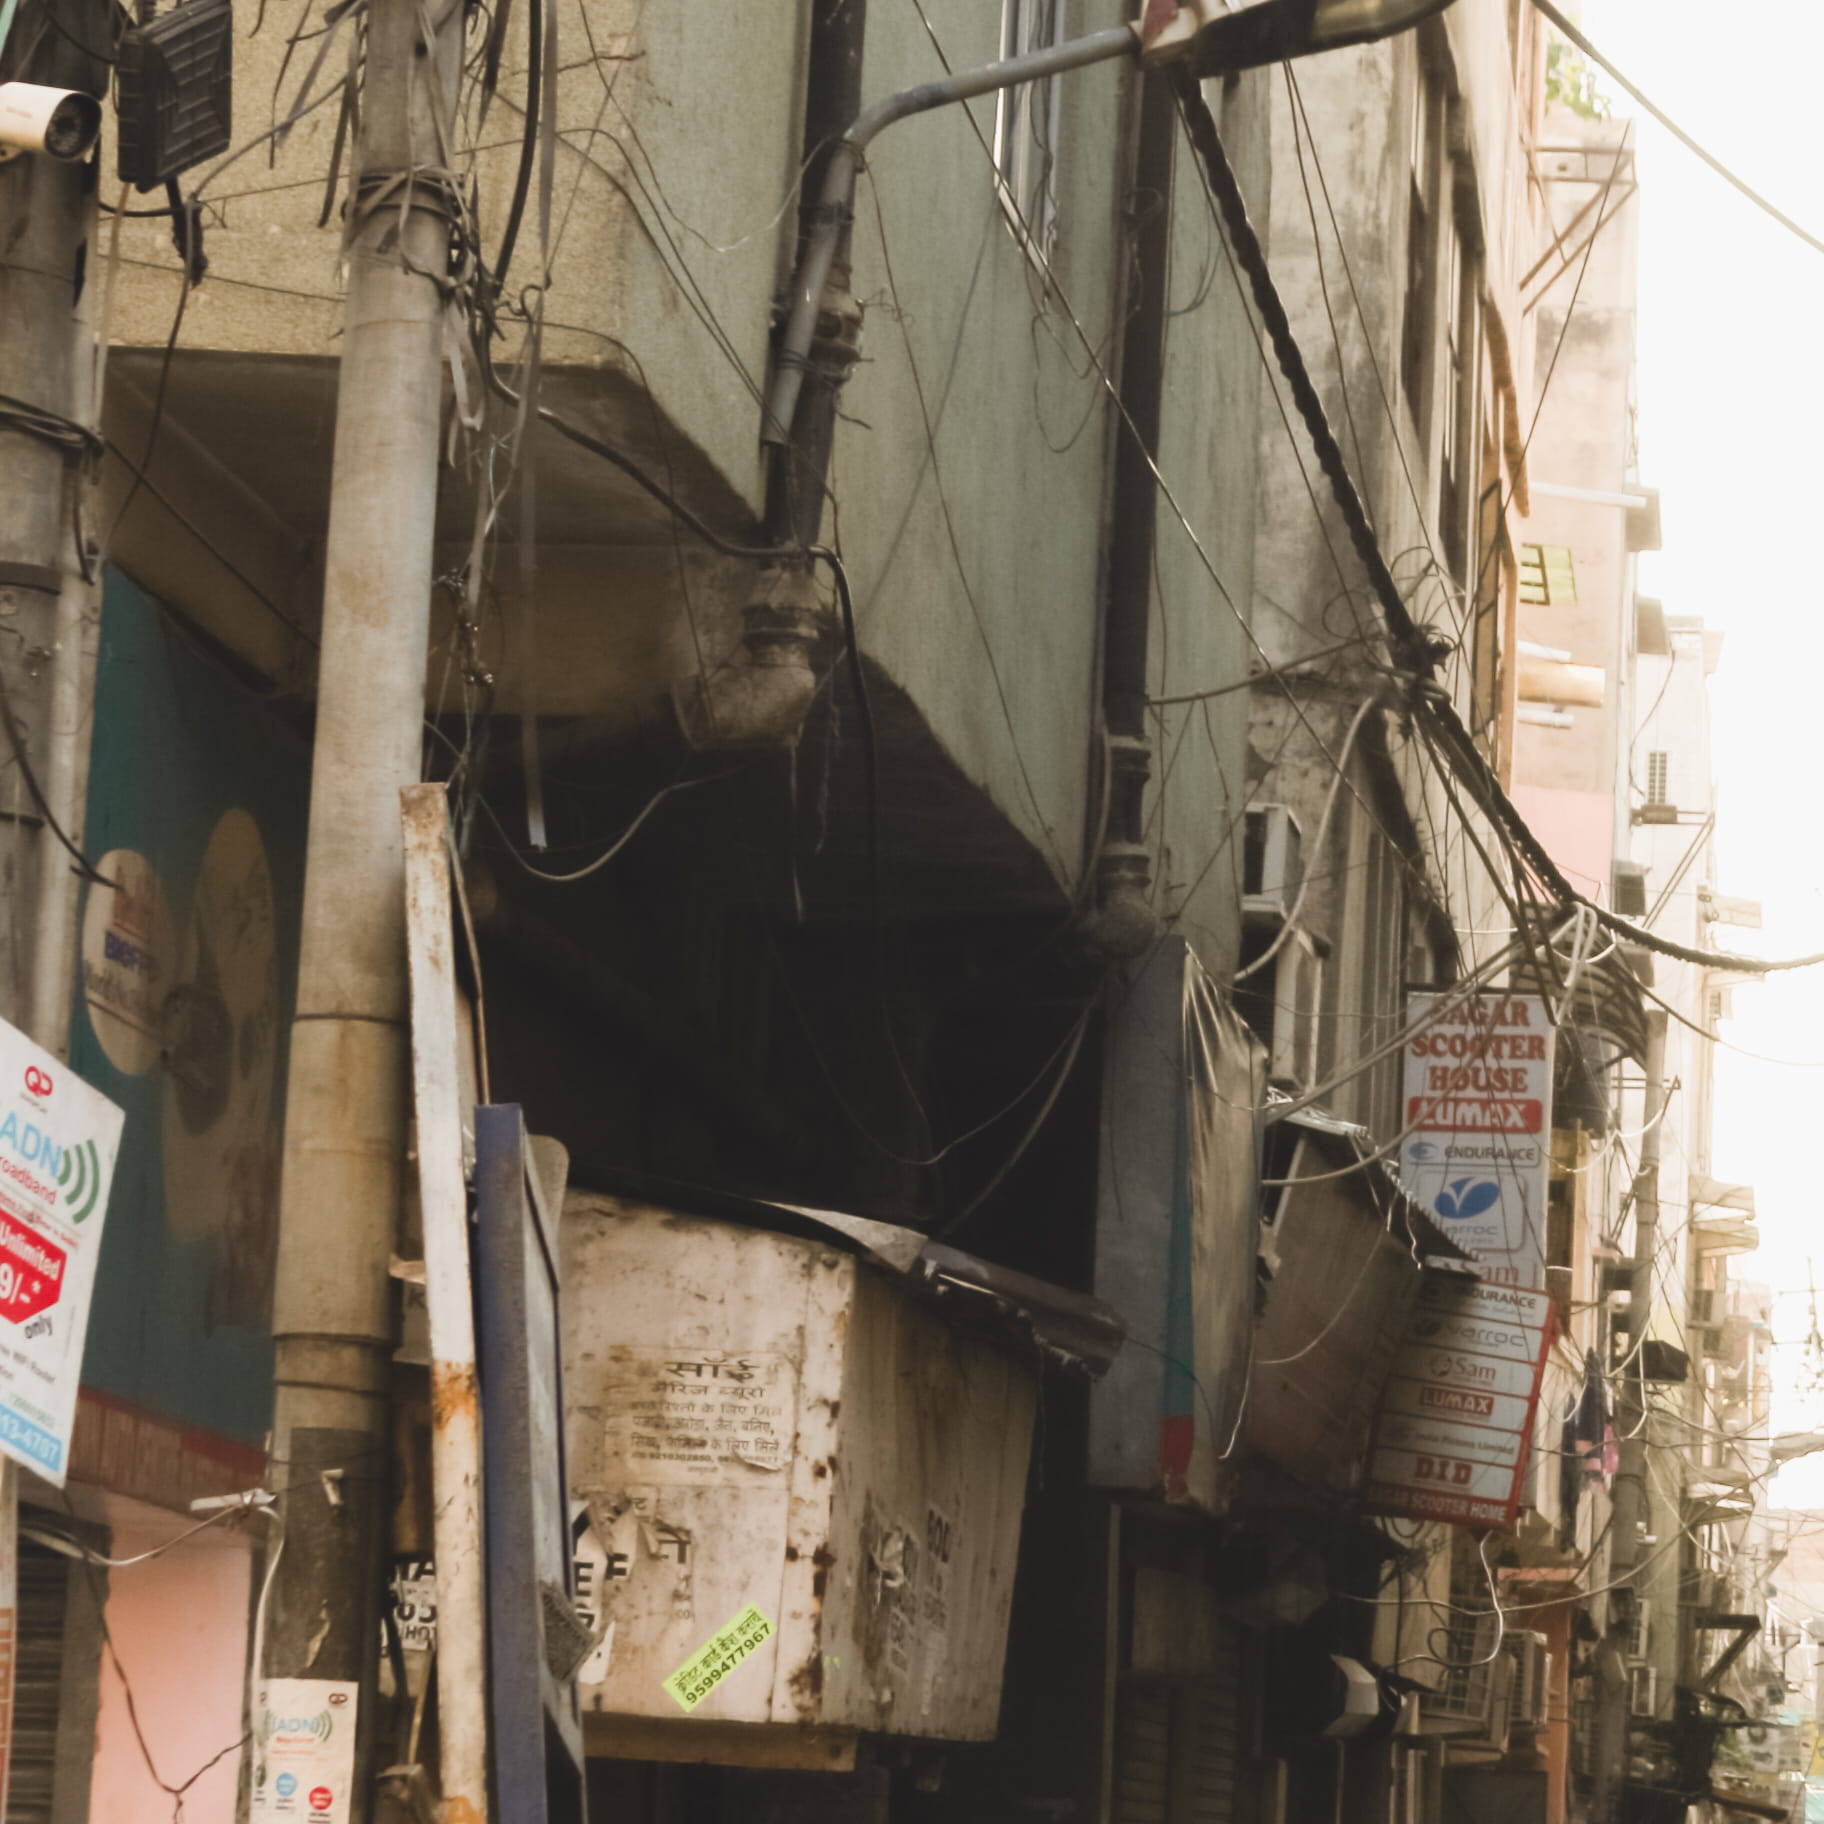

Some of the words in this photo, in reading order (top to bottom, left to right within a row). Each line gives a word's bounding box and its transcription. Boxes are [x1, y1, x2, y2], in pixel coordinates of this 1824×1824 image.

[1411, 1032, 1546, 1061] SCOOTER
[1428, 1066, 1528, 1093] HOUSE
[1418, 1099, 1527, 1129] LUMAX
[1445, 1146, 1535, 1161] ENDURANCE
[685, 1622, 771, 1704] 9599477967
